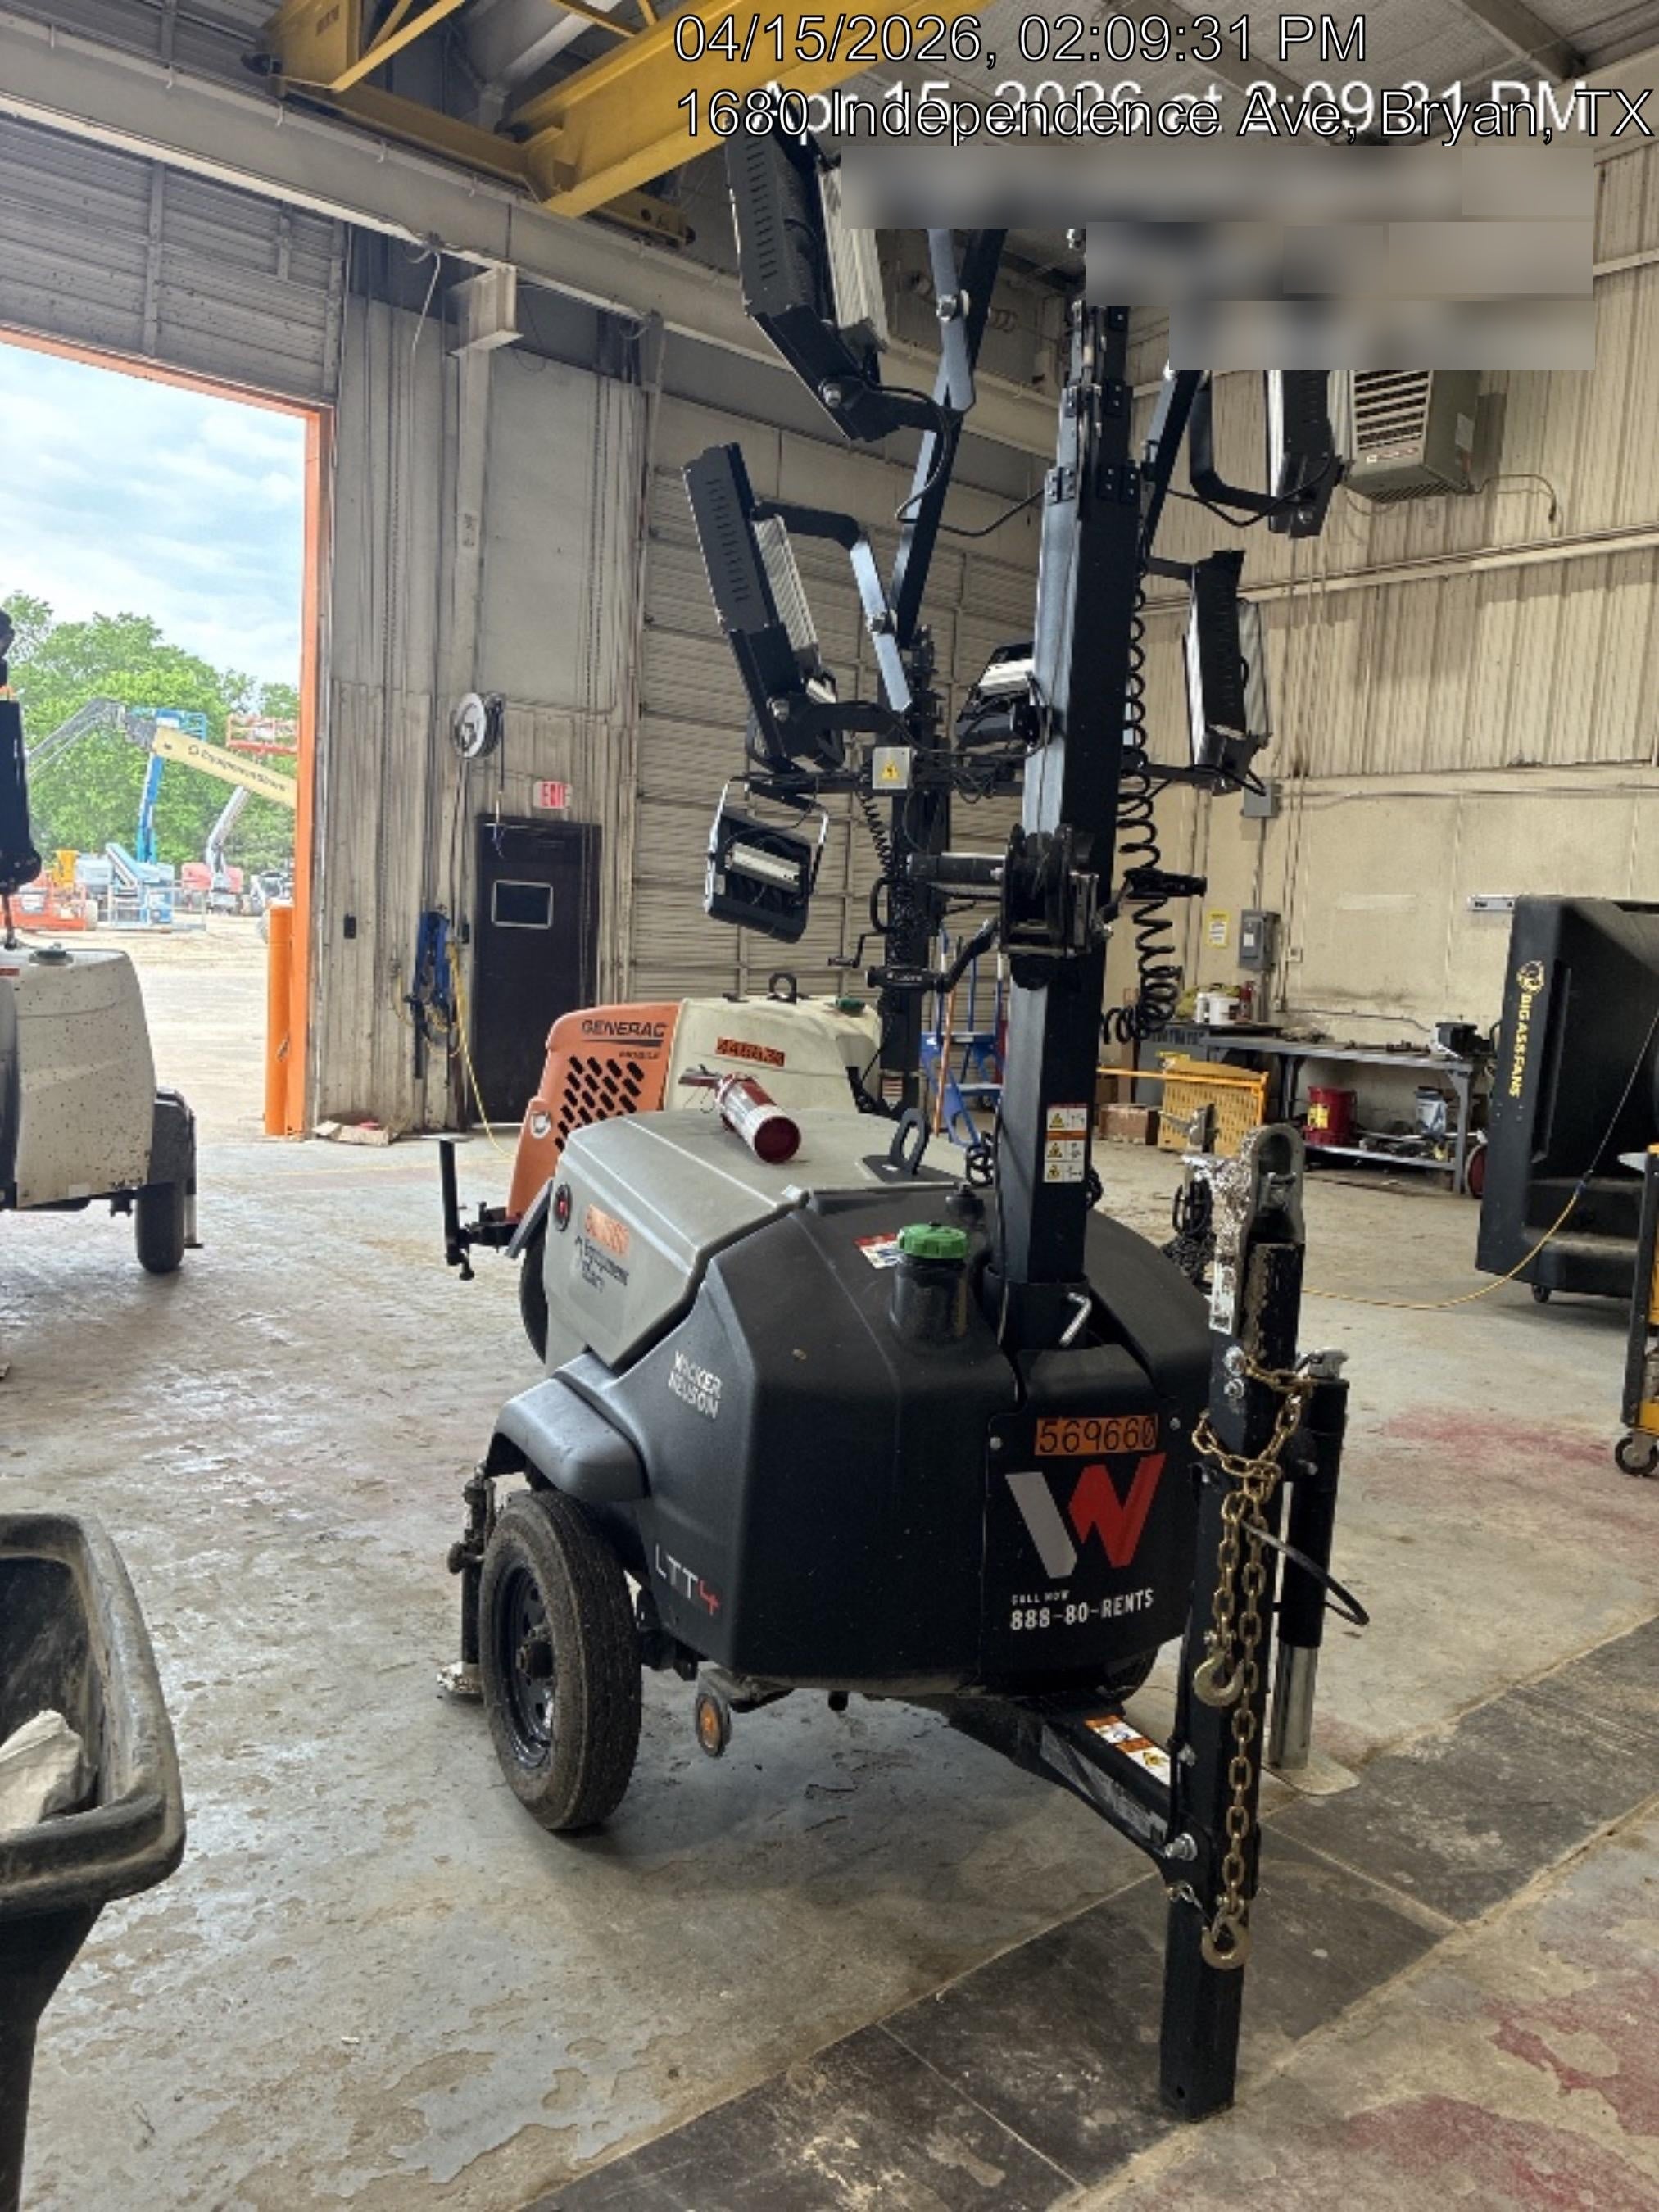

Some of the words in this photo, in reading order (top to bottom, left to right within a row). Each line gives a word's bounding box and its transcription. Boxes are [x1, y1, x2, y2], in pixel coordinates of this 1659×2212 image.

[542, 782, 567, 807] EXIT
[582, 1019, 668, 1038] GENERAC
[674, 1349, 723, 1399] WACKER
[668, 1371, 718, 1419] NEUSON
[1039, 1417, 1155, 1453] 569660
[656, 1543, 720, 1616] LTT4
[1012, 1593, 1040, 1606] CALL
